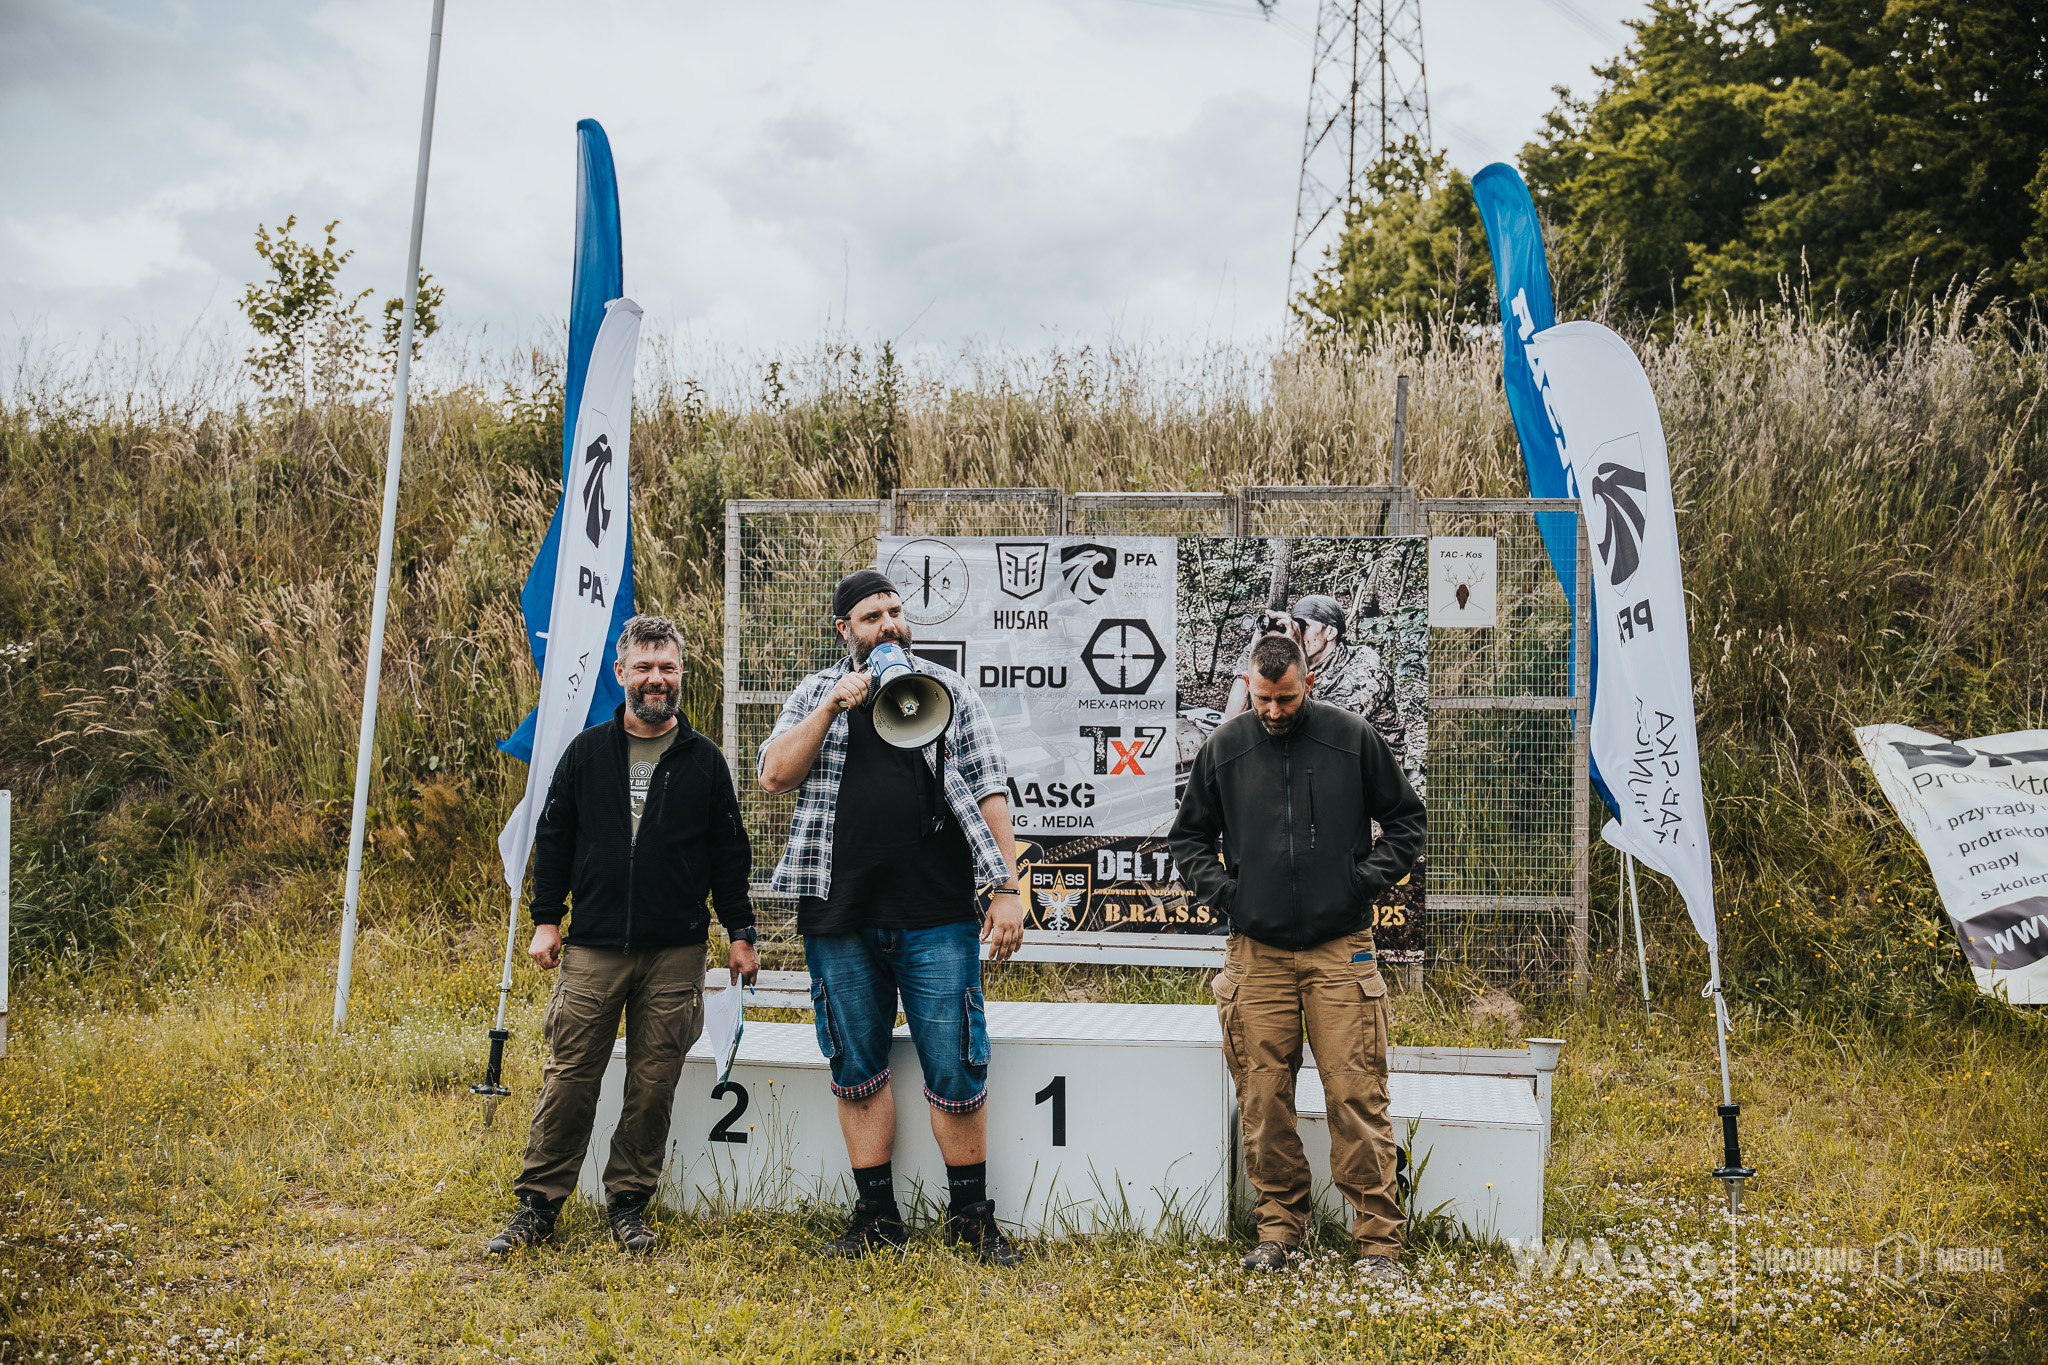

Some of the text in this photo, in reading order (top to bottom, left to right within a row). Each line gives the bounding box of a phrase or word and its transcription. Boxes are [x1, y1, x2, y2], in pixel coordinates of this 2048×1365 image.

[1124, 553, 1158, 566] PFA
[1440, 550, 1458, 558] TAC
[1465, 550, 1483, 559] Kos
[1124, 572, 1157, 580] POLSKA
[1124, 582, 1162, 590] FABRYKA
[1124, 591, 1163, 599] AMUNICJI
[994, 610, 1049, 630] HUSAR
[980, 666, 1067, 689] DIFOU
[1029, 690, 1068, 699] Szkolenia
[1042, 815, 1095, 828] MEDIA
[1947, 800, 2035, 831] przyrządy
[1968, 851, 2020, 877] mapy
[1033, 869, 1085, 890] BRASS
[1105, 902, 1218, 924] B.R.A.S.S.
[707, 1080, 749, 1144] 2
[1034, 1075, 1066, 1147] 1
